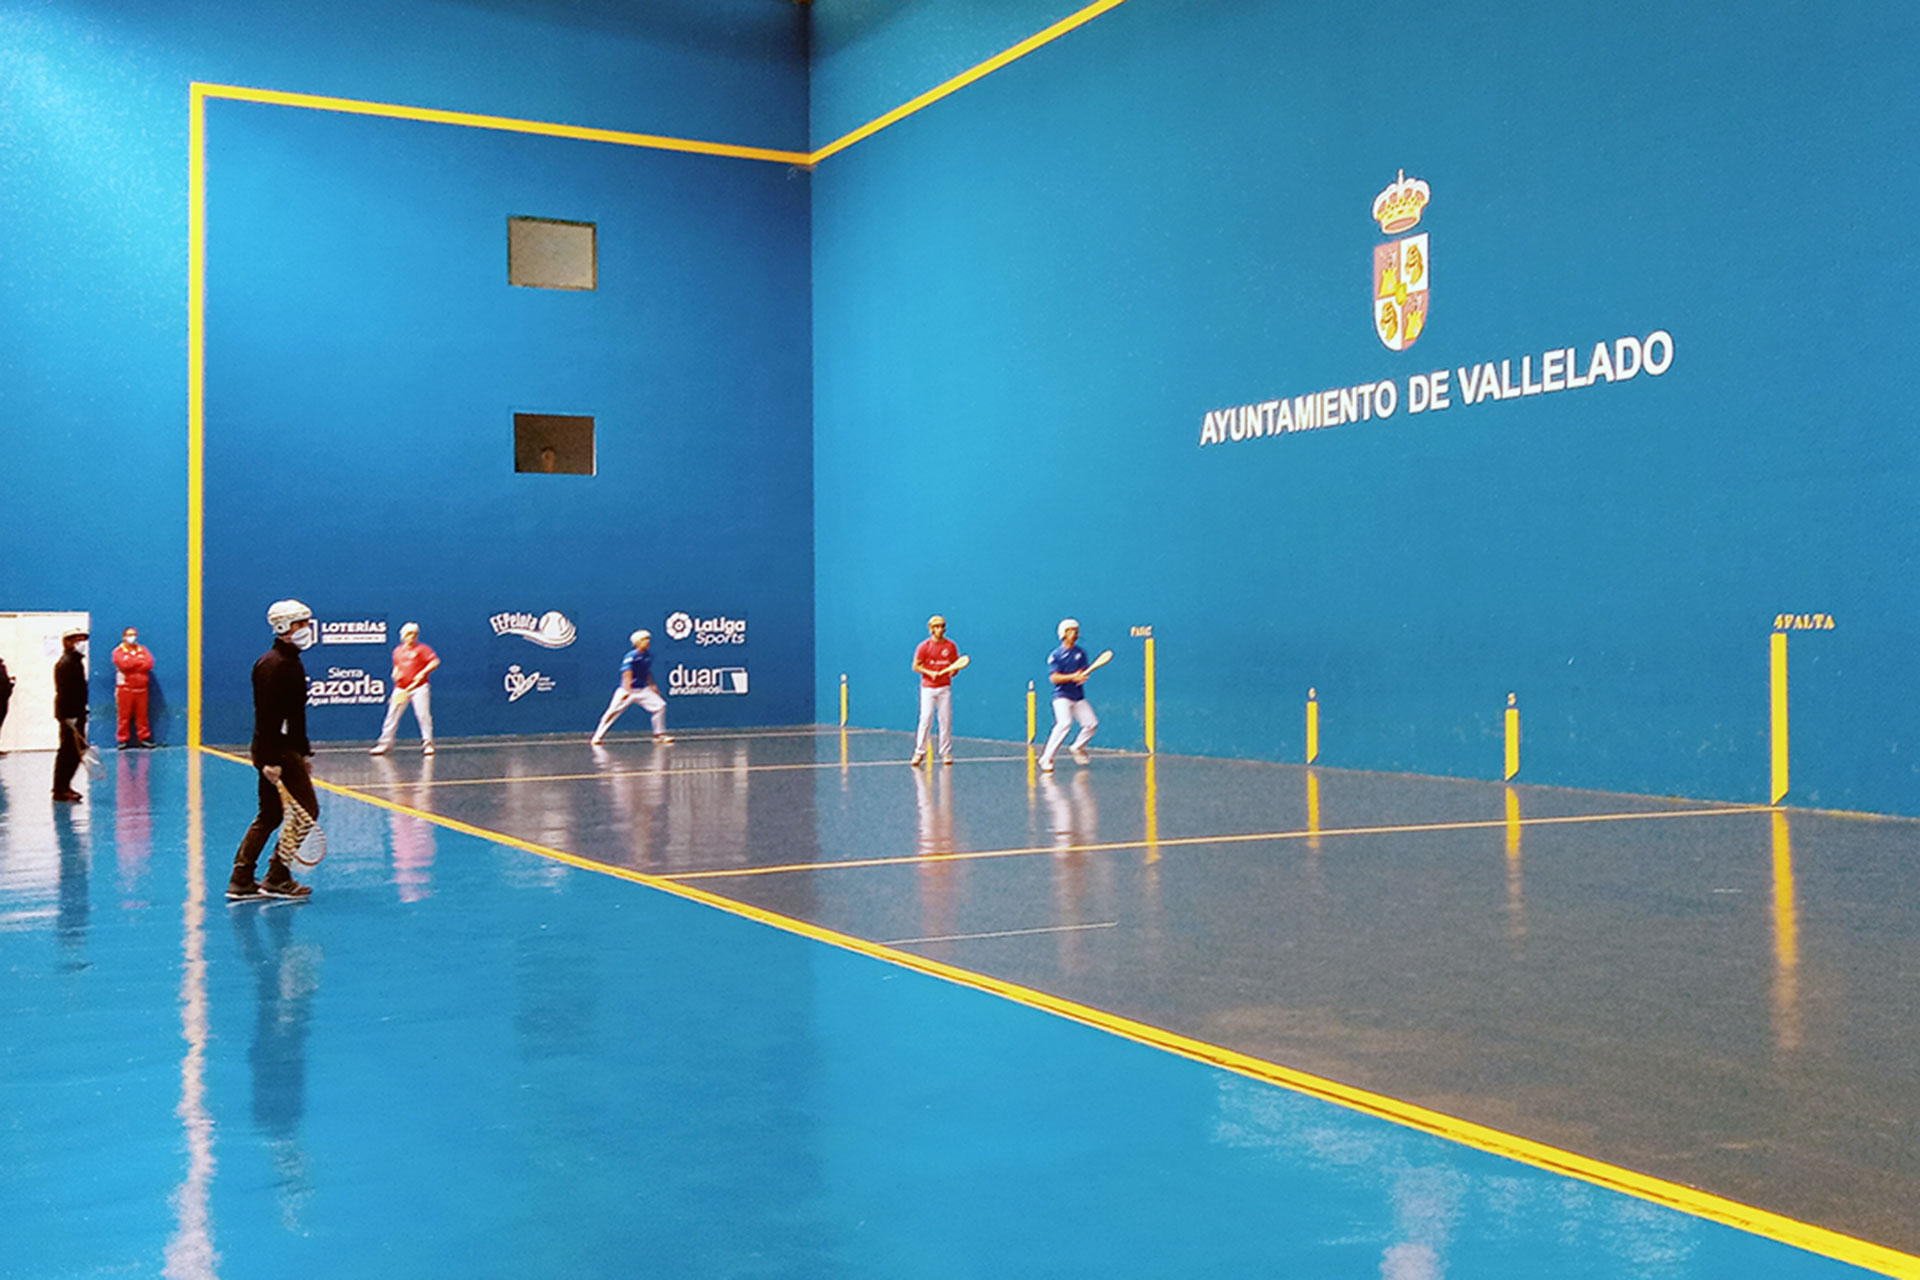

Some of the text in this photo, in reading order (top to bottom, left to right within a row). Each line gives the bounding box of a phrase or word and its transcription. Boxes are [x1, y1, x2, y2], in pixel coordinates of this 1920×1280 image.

[1199, 330, 1675, 446] AYUNTAMIENTO DE VALLELADO
[321, 620, 387, 633] LOTERÍAS
[694, 616, 746, 634] LaLiga
[695, 631, 745, 647] Sports
[305, 674, 385, 697] azorla
